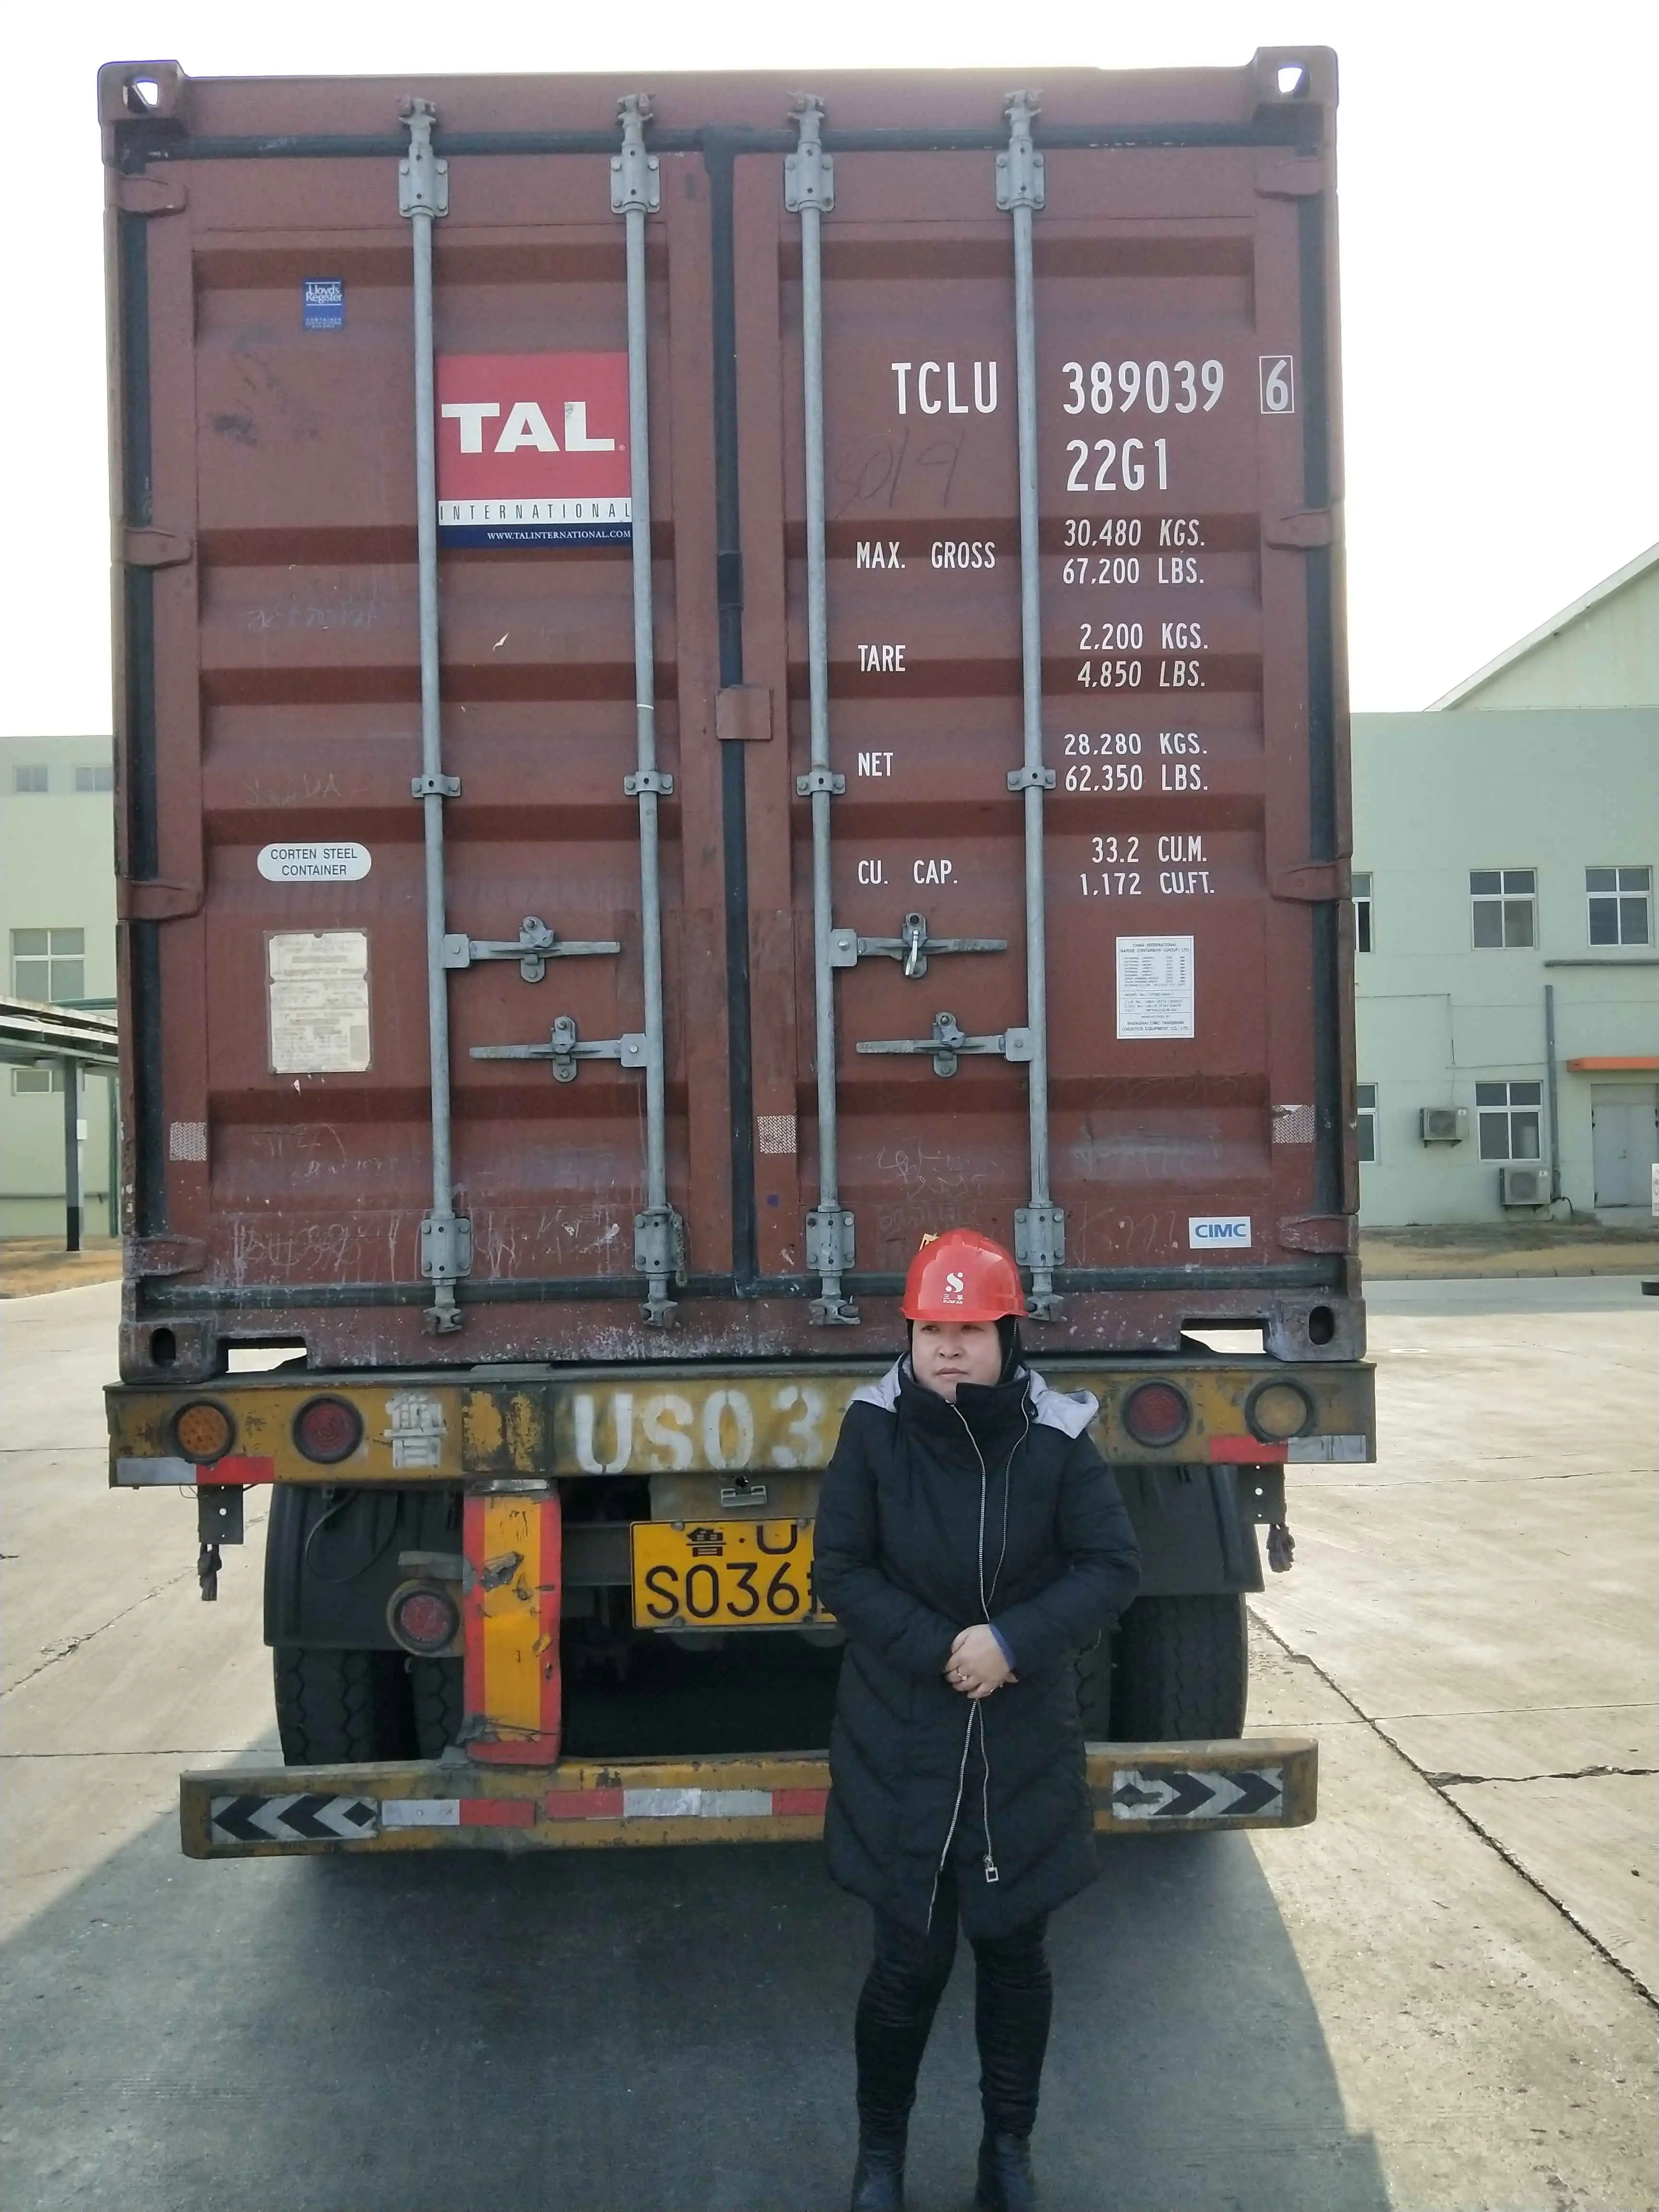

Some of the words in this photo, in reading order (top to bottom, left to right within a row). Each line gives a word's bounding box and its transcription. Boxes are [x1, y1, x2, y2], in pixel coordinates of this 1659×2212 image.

[891, 361, 997, 414] TCLU
[1062, 360, 1224, 414] 3889039
[1266, 359, 1288, 411] 6
[442, 401, 615, 453] TAL
[1066, 438, 1167, 491] 22G1
[440, 503, 630, 520] INTERNATIONAL
[487, 529, 631, 540] WWW.TALINTERNATIONAL.COM
[1064, 519, 1141, 547] 30,480
[1159, 519, 1205, 546] KGS.
[857, 541, 905, 569] MAX.
[931, 541, 996, 568] GROSS
[1063, 557, 1139, 584] 67,200
[1158, 557, 1204, 584] LBS.
[1080, 623, 1143, 650] 2,200
[1162, 623, 1208, 649] KGS.
[858, 645, 906, 672] TARE
[1077, 661, 1141, 687] 4,850
[1159, 661, 1205, 687] LBS.
[1064, 733, 1142, 755] 28,280
[1159, 733, 1207, 754] KGS.
[858, 752, 893, 776] NET
[1065, 764, 1143, 791] 62,350
[1162, 764, 1208, 791] LBS.
[271, 849, 317, 860] CORTEN
[324, 848, 357, 859] STEEL
[1092, 837, 1139, 863] 33.2
[1158, 836, 1207, 862] CU.M.
[282, 865, 347, 876] CONTAINER
[858, 860, 889, 884] CU.
[914, 860, 958, 884] CAP.
[1080, 873, 1142, 895] 1,172
[1160, 871, 1214, 894] CU.FT.
[1195, 1224, 1246, 1238] CIMC
